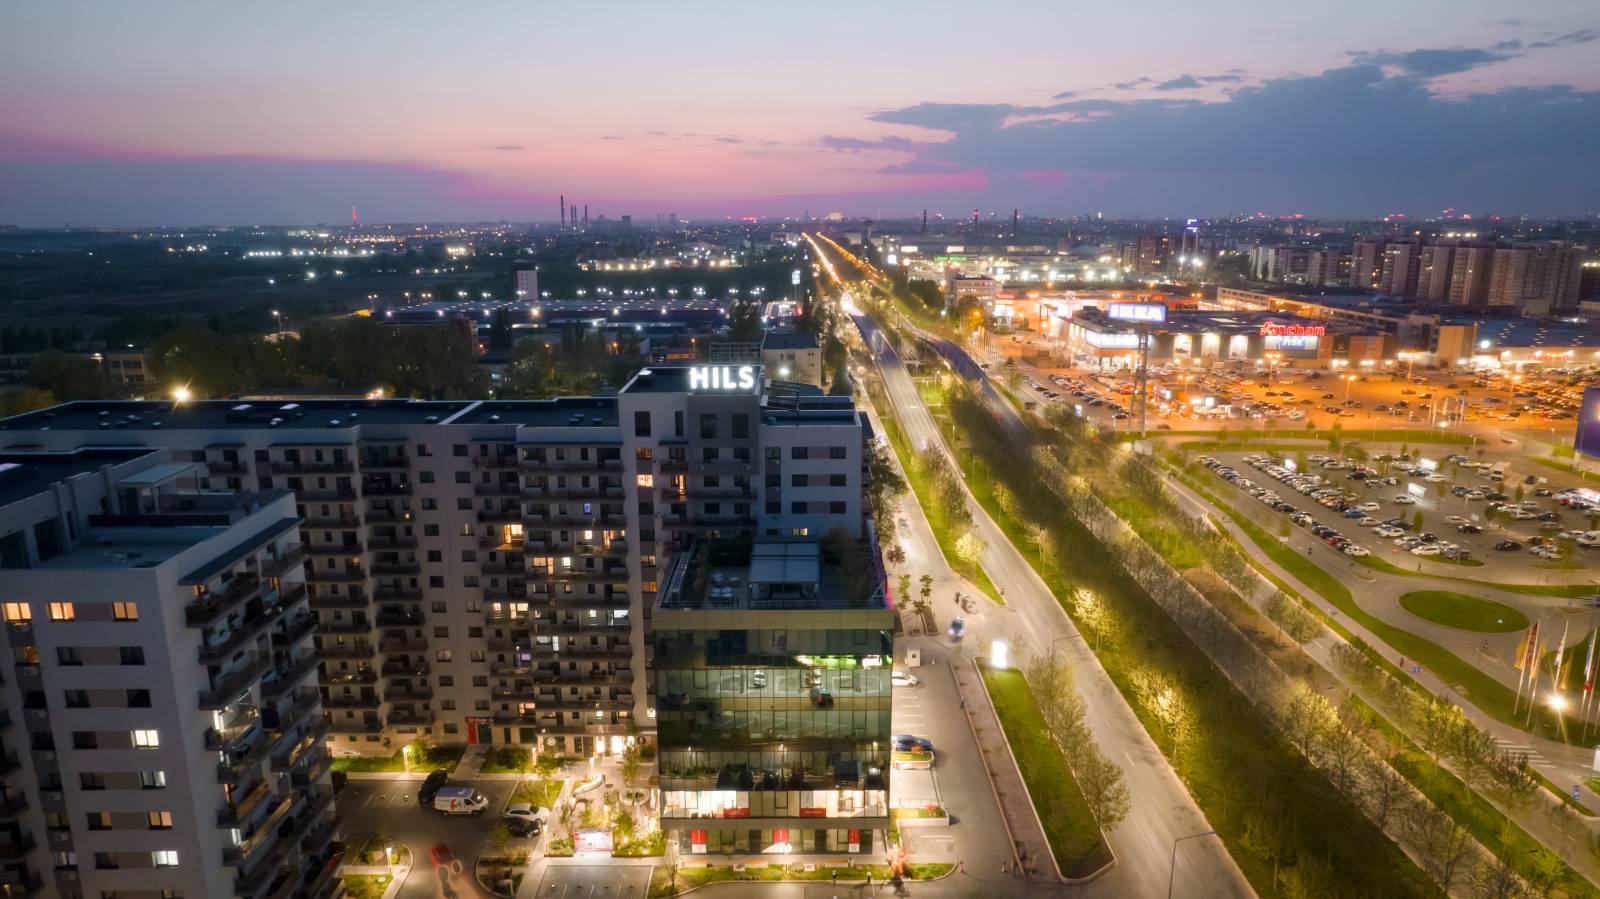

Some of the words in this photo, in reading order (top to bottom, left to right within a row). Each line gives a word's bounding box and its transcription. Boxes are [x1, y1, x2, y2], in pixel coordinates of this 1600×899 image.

[1110, 304, 1163, 320] IKEA
[1260, 321, 1325, 336] Auchan
[690, 366, 754, 389] HILS
